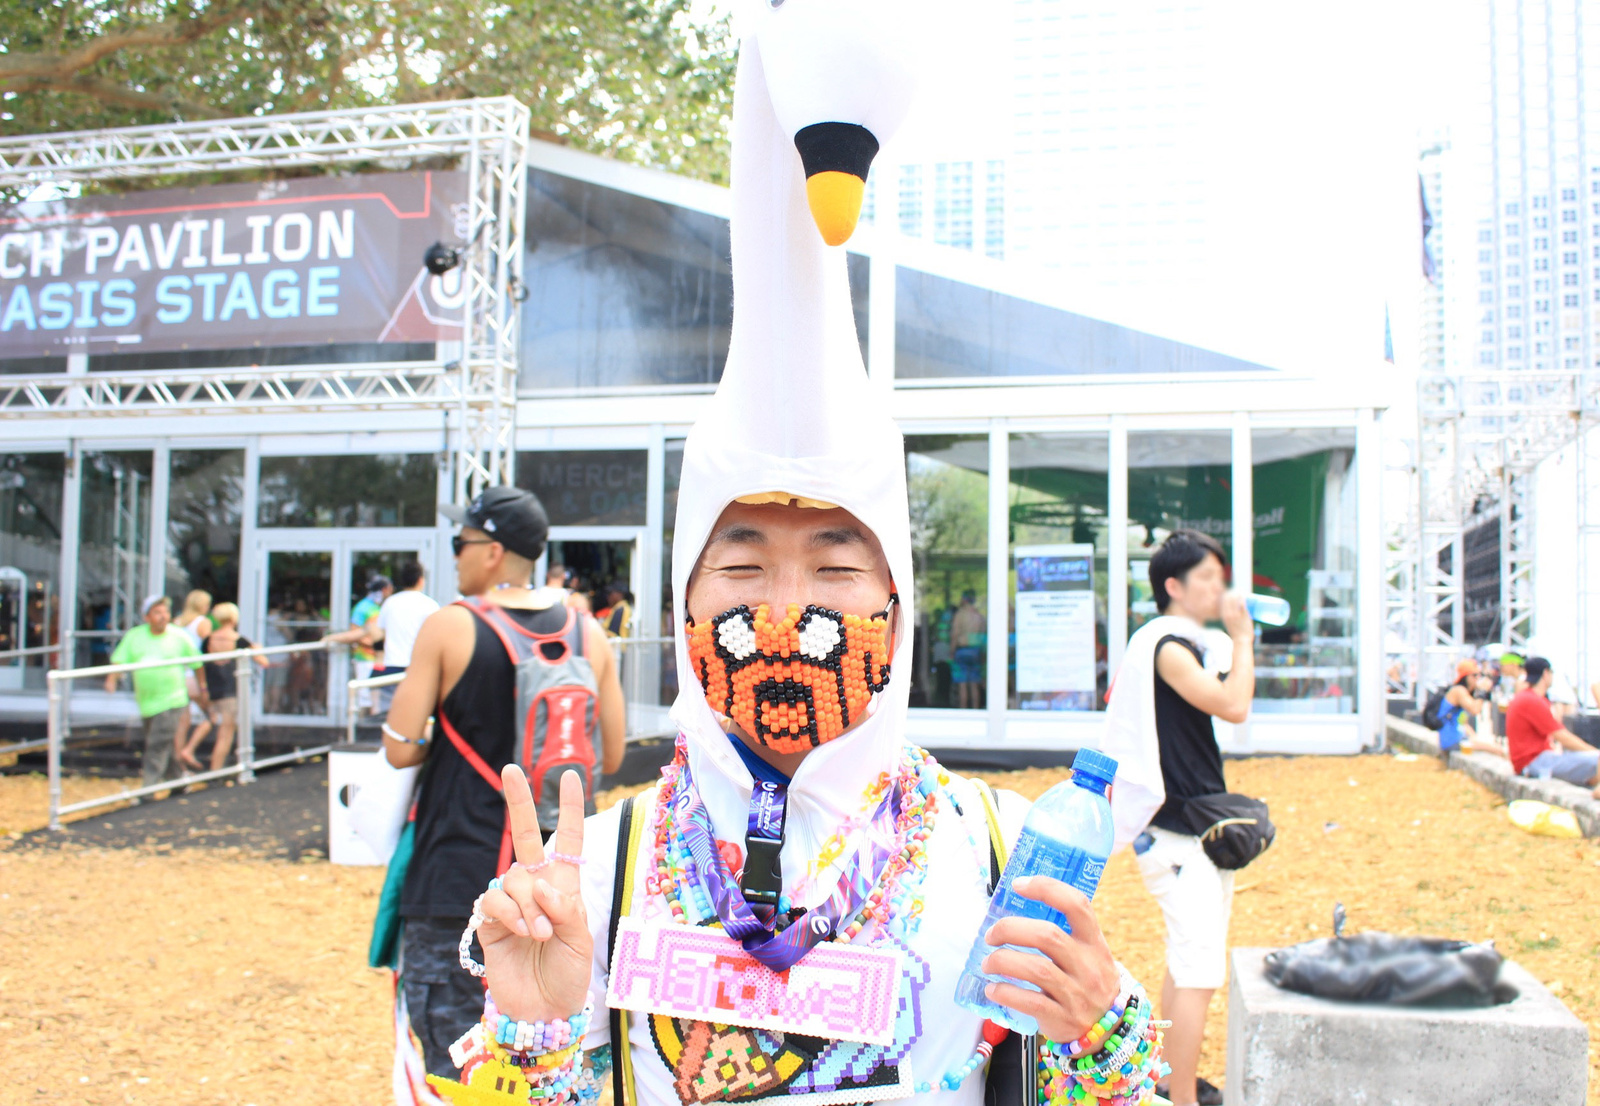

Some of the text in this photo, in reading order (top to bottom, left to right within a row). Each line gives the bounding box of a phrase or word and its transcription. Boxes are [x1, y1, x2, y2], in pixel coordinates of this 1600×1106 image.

[0, 209, 355, 279] CH PAVILION
[0, 266, 340, 331] ASIS STAGE
[540, 463, 646, 487] MERCH
[763, 791, 775, 830] ULTRA
